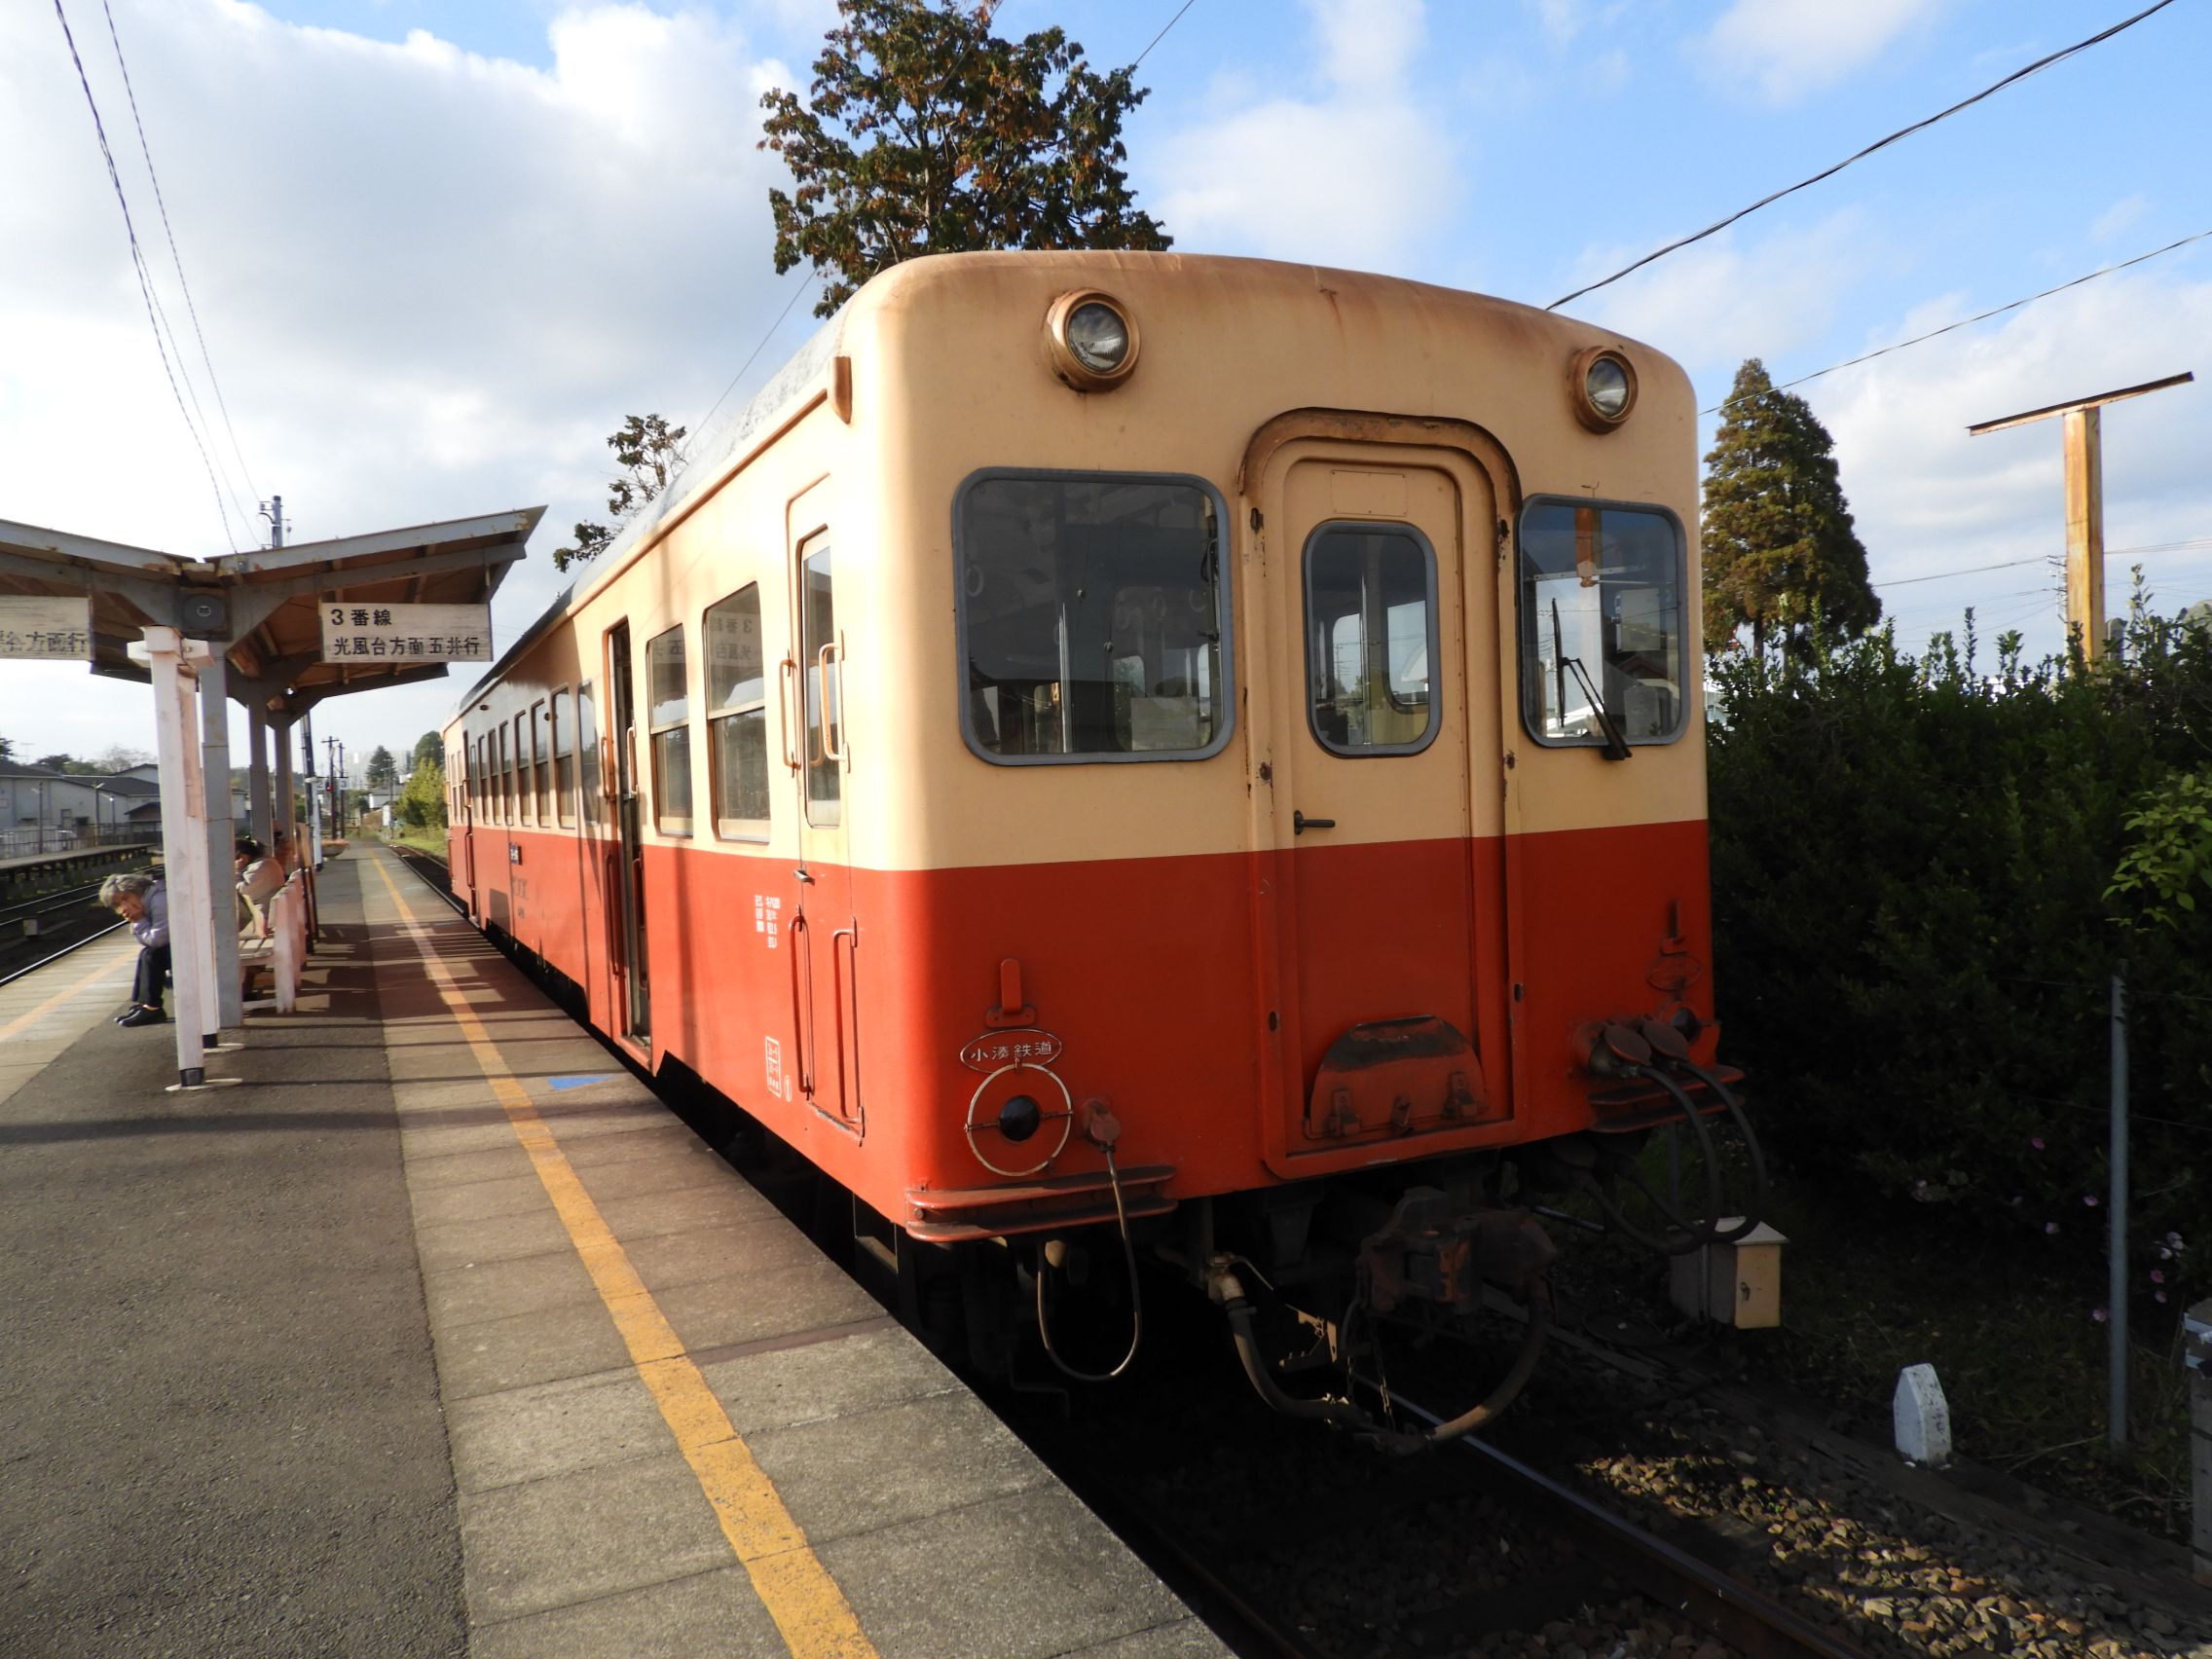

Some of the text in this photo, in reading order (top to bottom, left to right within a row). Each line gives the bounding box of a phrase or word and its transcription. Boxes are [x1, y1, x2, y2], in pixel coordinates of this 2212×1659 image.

[331, 608, 392, 627] 3番線
[0, 631, 87, 653] 台方面行
